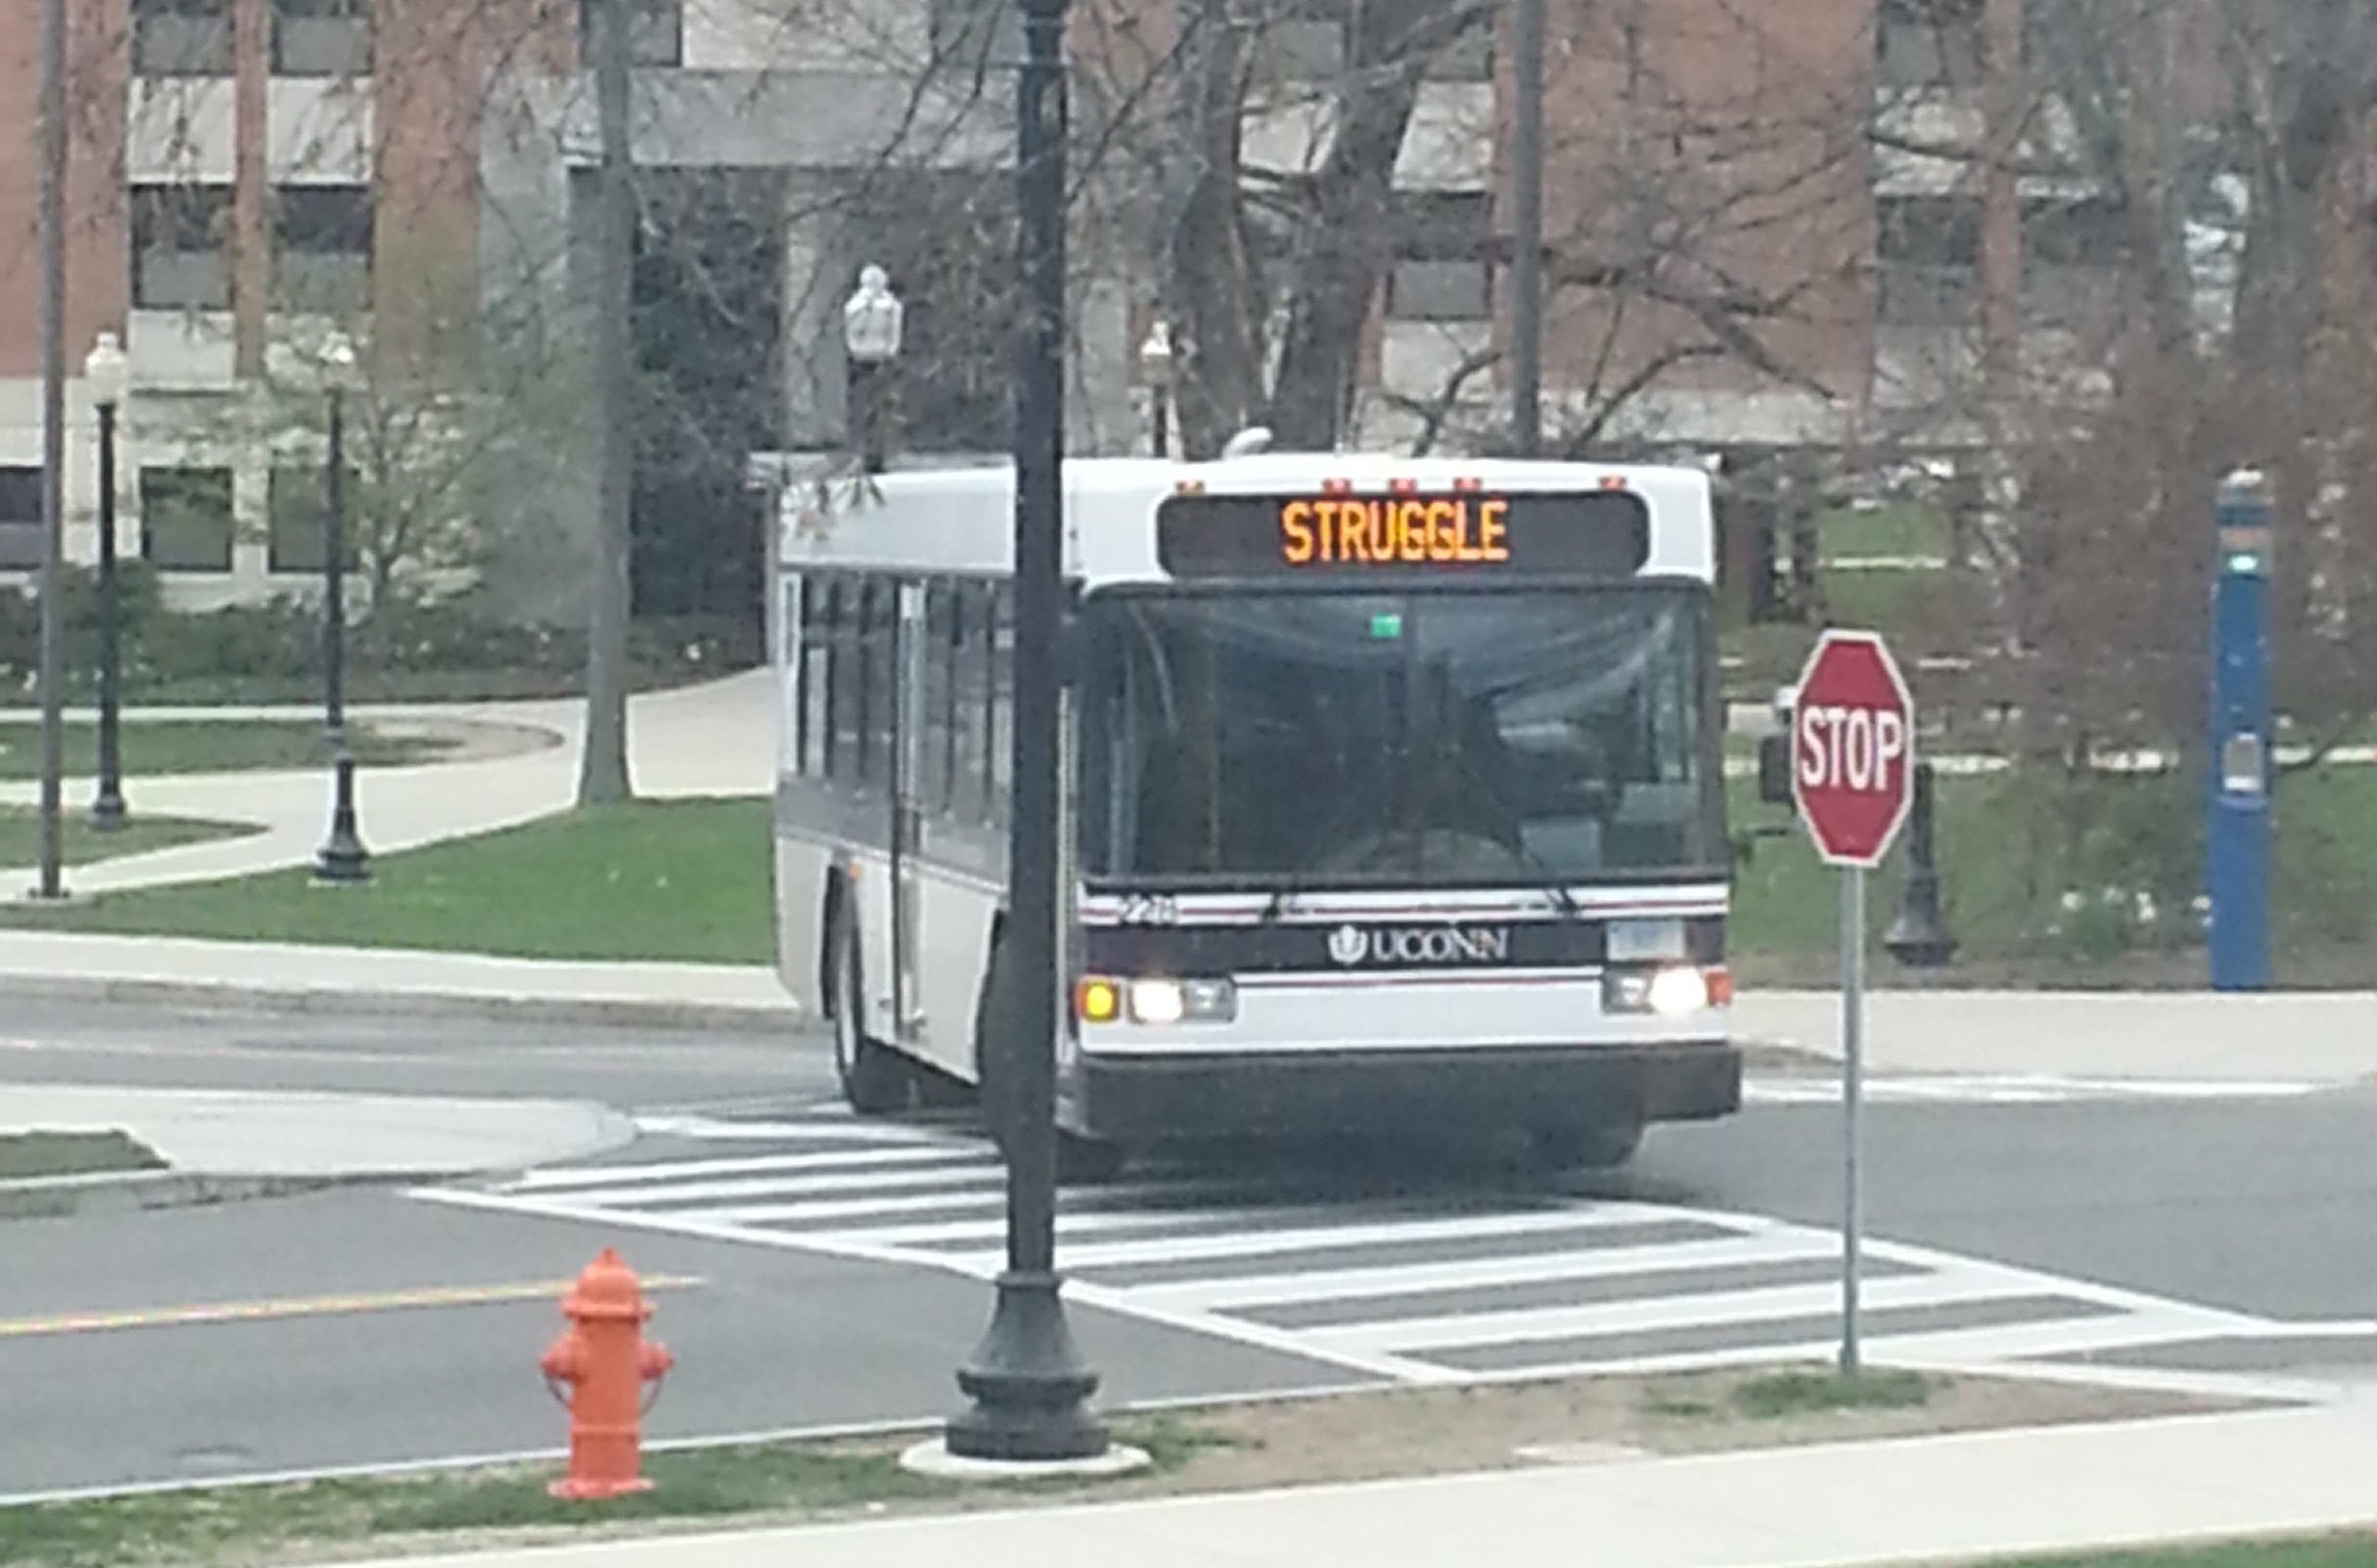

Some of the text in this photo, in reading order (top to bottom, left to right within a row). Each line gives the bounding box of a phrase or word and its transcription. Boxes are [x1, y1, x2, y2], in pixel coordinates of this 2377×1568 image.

[1281, 499, 1510, 562] STRUGGLE
[1801, 705, 1902, 791] STOP
[1373, 927, 1509, 962] UCONN
